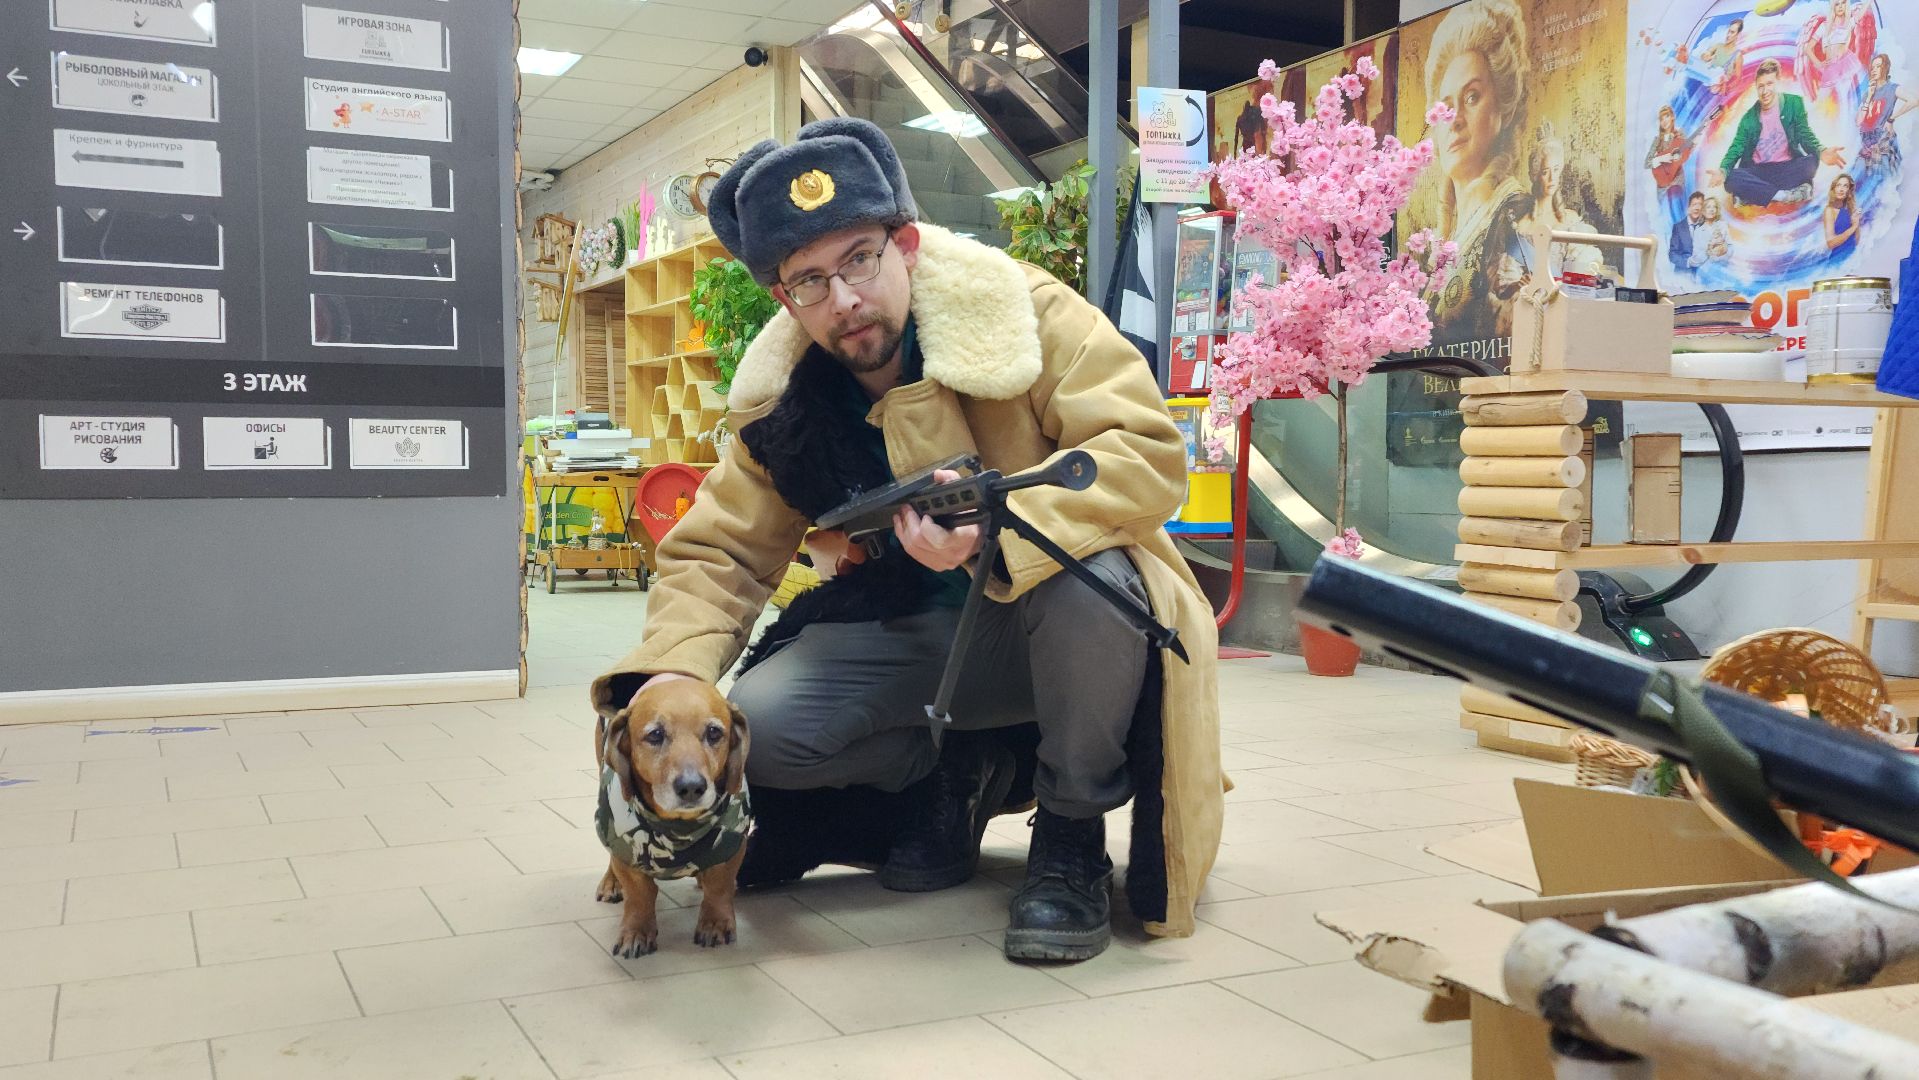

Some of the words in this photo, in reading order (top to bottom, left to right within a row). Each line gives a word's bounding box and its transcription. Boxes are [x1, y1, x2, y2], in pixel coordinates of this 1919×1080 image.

[337, 15, 384, 30] ИГРОВАЯ
[386, 21, 413, 33] ЗОНА
[65, 61, 148, 79] РЫБОЛОВНЫЙ
[150, 70, 202, 85] МАГАИН
[97, 78, 150, 90] ЦОКОЛЬНЫЙ
[152, 84, 175, 92] ЭТАЖ
[312, 82, 349, 94] Студия
[351, 87, 412, 99] английского
[414, 94, 443, 102] языка
[381, 107, 421, 119] A-STAR
[69, 133, 112, 146] Крепеж
[124, 138, 183, 152] фурнитура
[1146, 131, 1181, 140] ТОПТЫЖКА
[84, 288, 131, 300] РЕМОНТ
[135, 291, 204, 303] ТЕЛЕФОНОВ
[223, 373, 237, 391] 3
[243, 373, 307, 392] ЭТАЖ
[1423, 375, 1461, 395] ВЕЛ
[70, 421, 92, 431] АРТ
[101, 421, 146, 432] СТУДИЯ
[246, 423, 286, 433] ОФИСЫ
[369, 424, 408, 434] BEAUTY
[409, 426, 446, 435] CENTER
[74, 434, 142, 445] РИСОВАНИЯ
